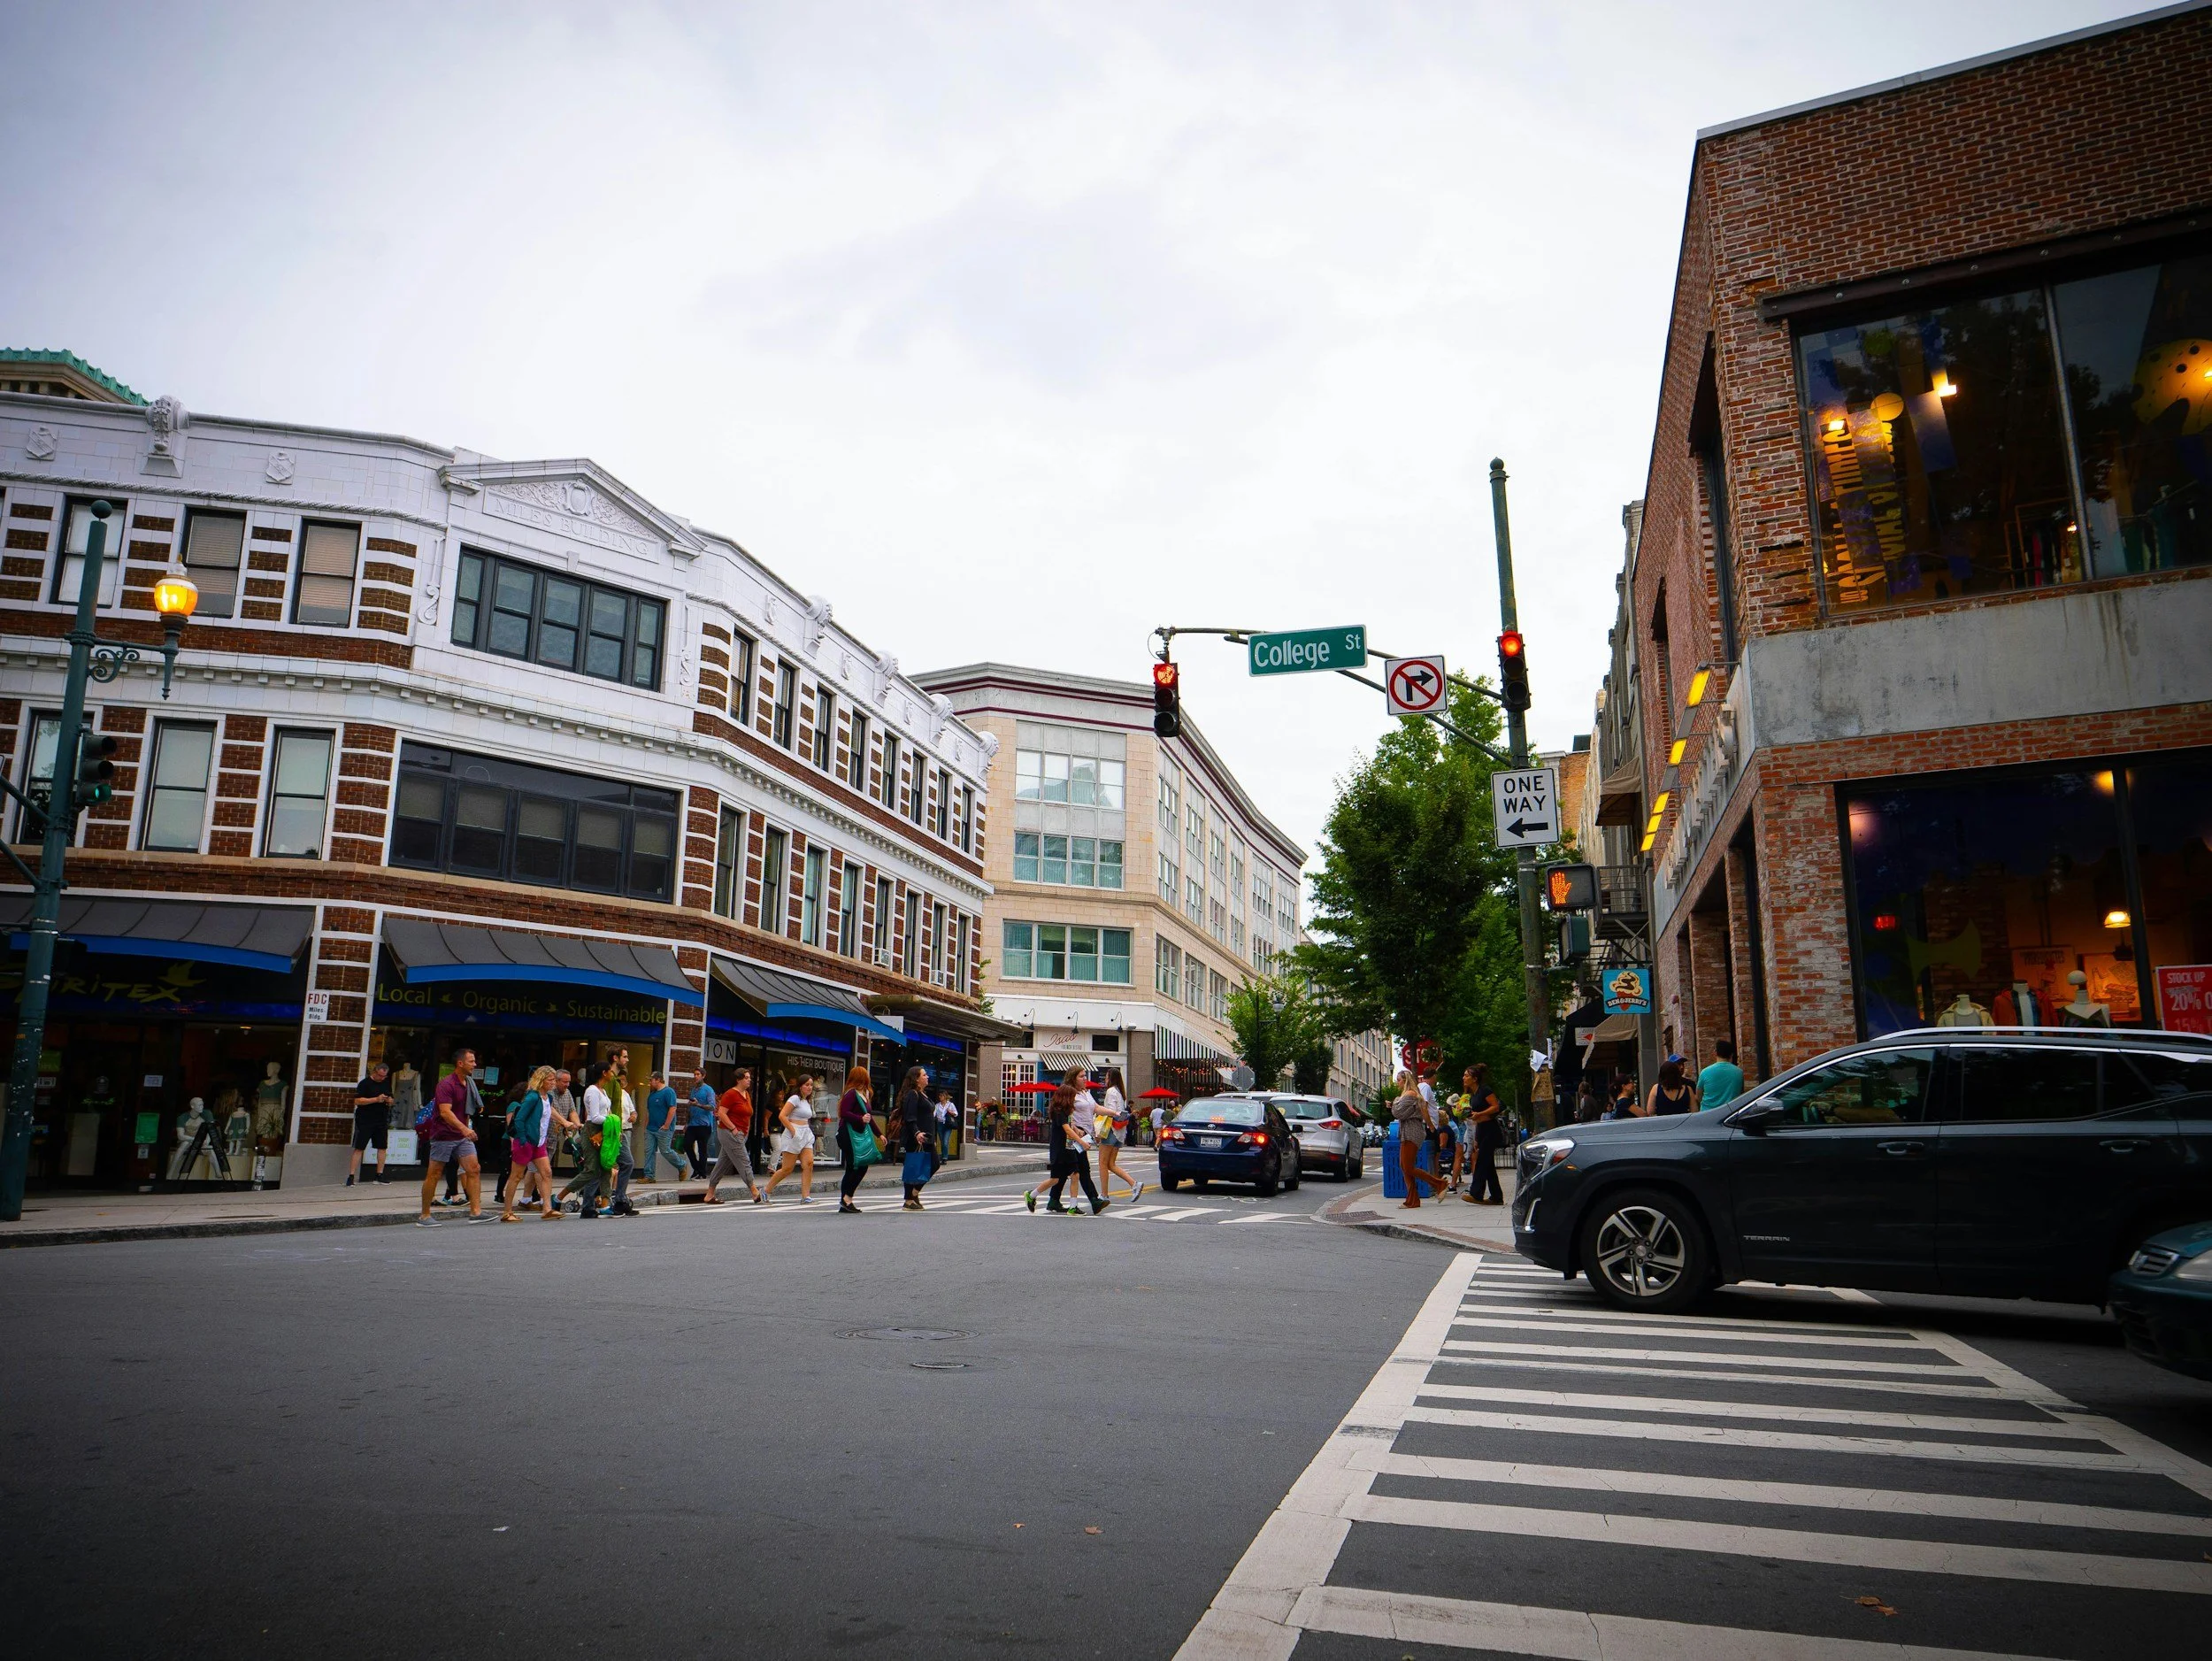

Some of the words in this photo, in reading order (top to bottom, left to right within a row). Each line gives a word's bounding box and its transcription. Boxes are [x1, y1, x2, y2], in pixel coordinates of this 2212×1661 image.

[495, 499, 553, 527] MILES
[560, 518, 649, 555] BUILDING
[1254, 639, 1331, 669] College
[1345, 633, 1361, 651] St
[1503, 775, 1545, 794] ONE
[1503, 795, 1548, 813] WAY
[2167, 972, 2193, 984] STOCK
[2193, 971, 2206, 982] UP
[308, 993, 327, 1004] FDC
[378, 983, 432, 1004] Local
[463, 990, 537, 1015] Organic
[565, 1000, 666, 1025] Sustainable
[2171, 992, 2202, 1011] 20%
[814, 1059, 844, 1073] BOUTIQUE
